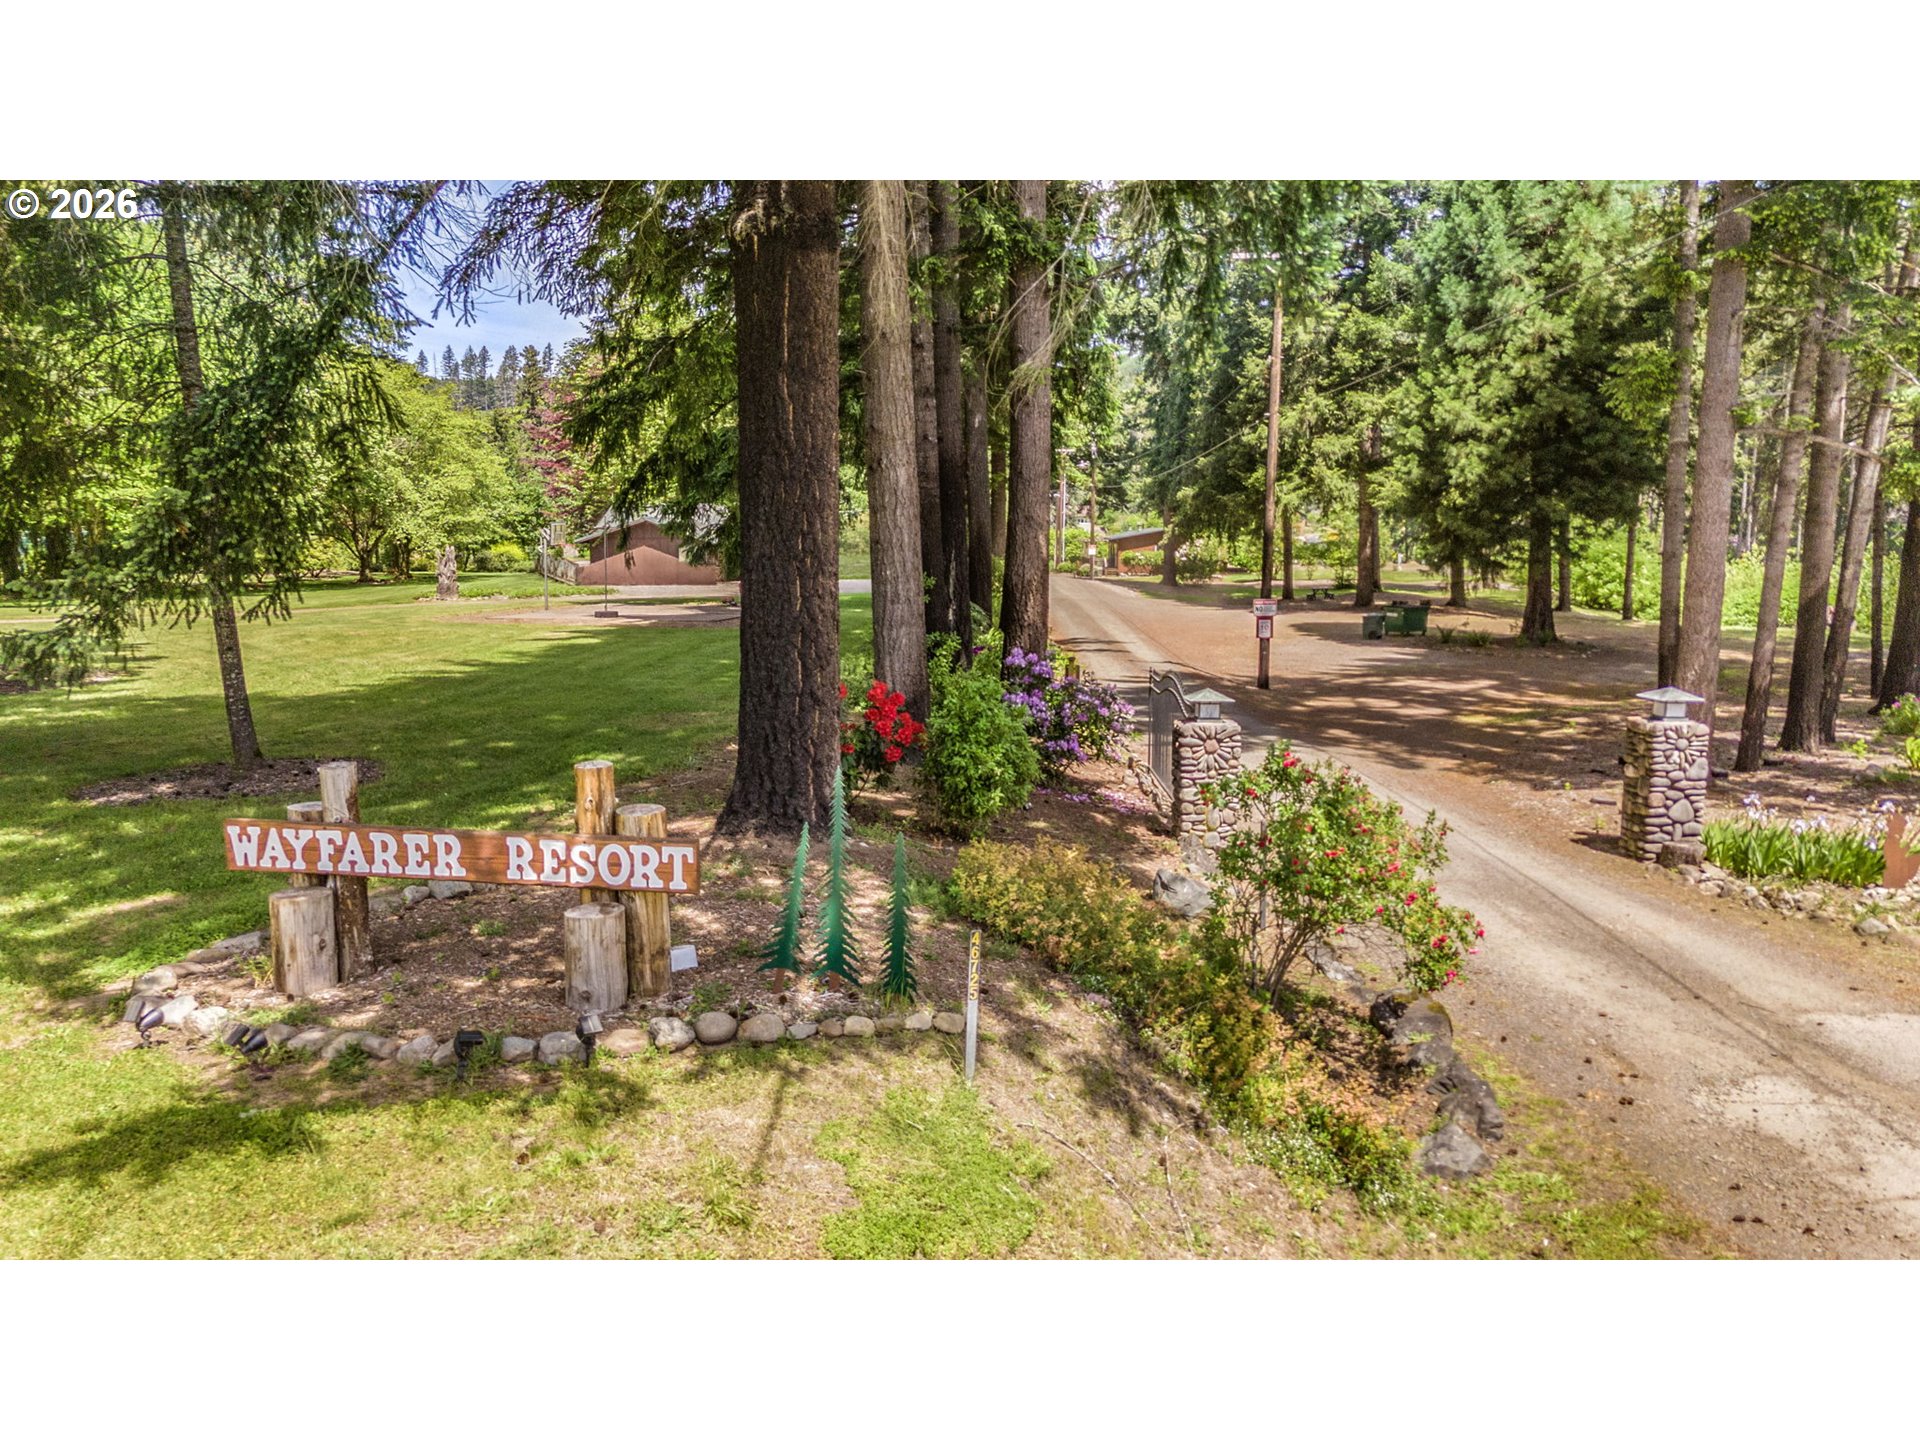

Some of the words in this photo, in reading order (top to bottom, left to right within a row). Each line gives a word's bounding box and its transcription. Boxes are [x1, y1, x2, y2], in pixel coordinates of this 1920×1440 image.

[226, 825, 467, 877] WAYFARER
[505, 836, 694, 890] RESORT
[969, 931, 980, 1000] 46725
